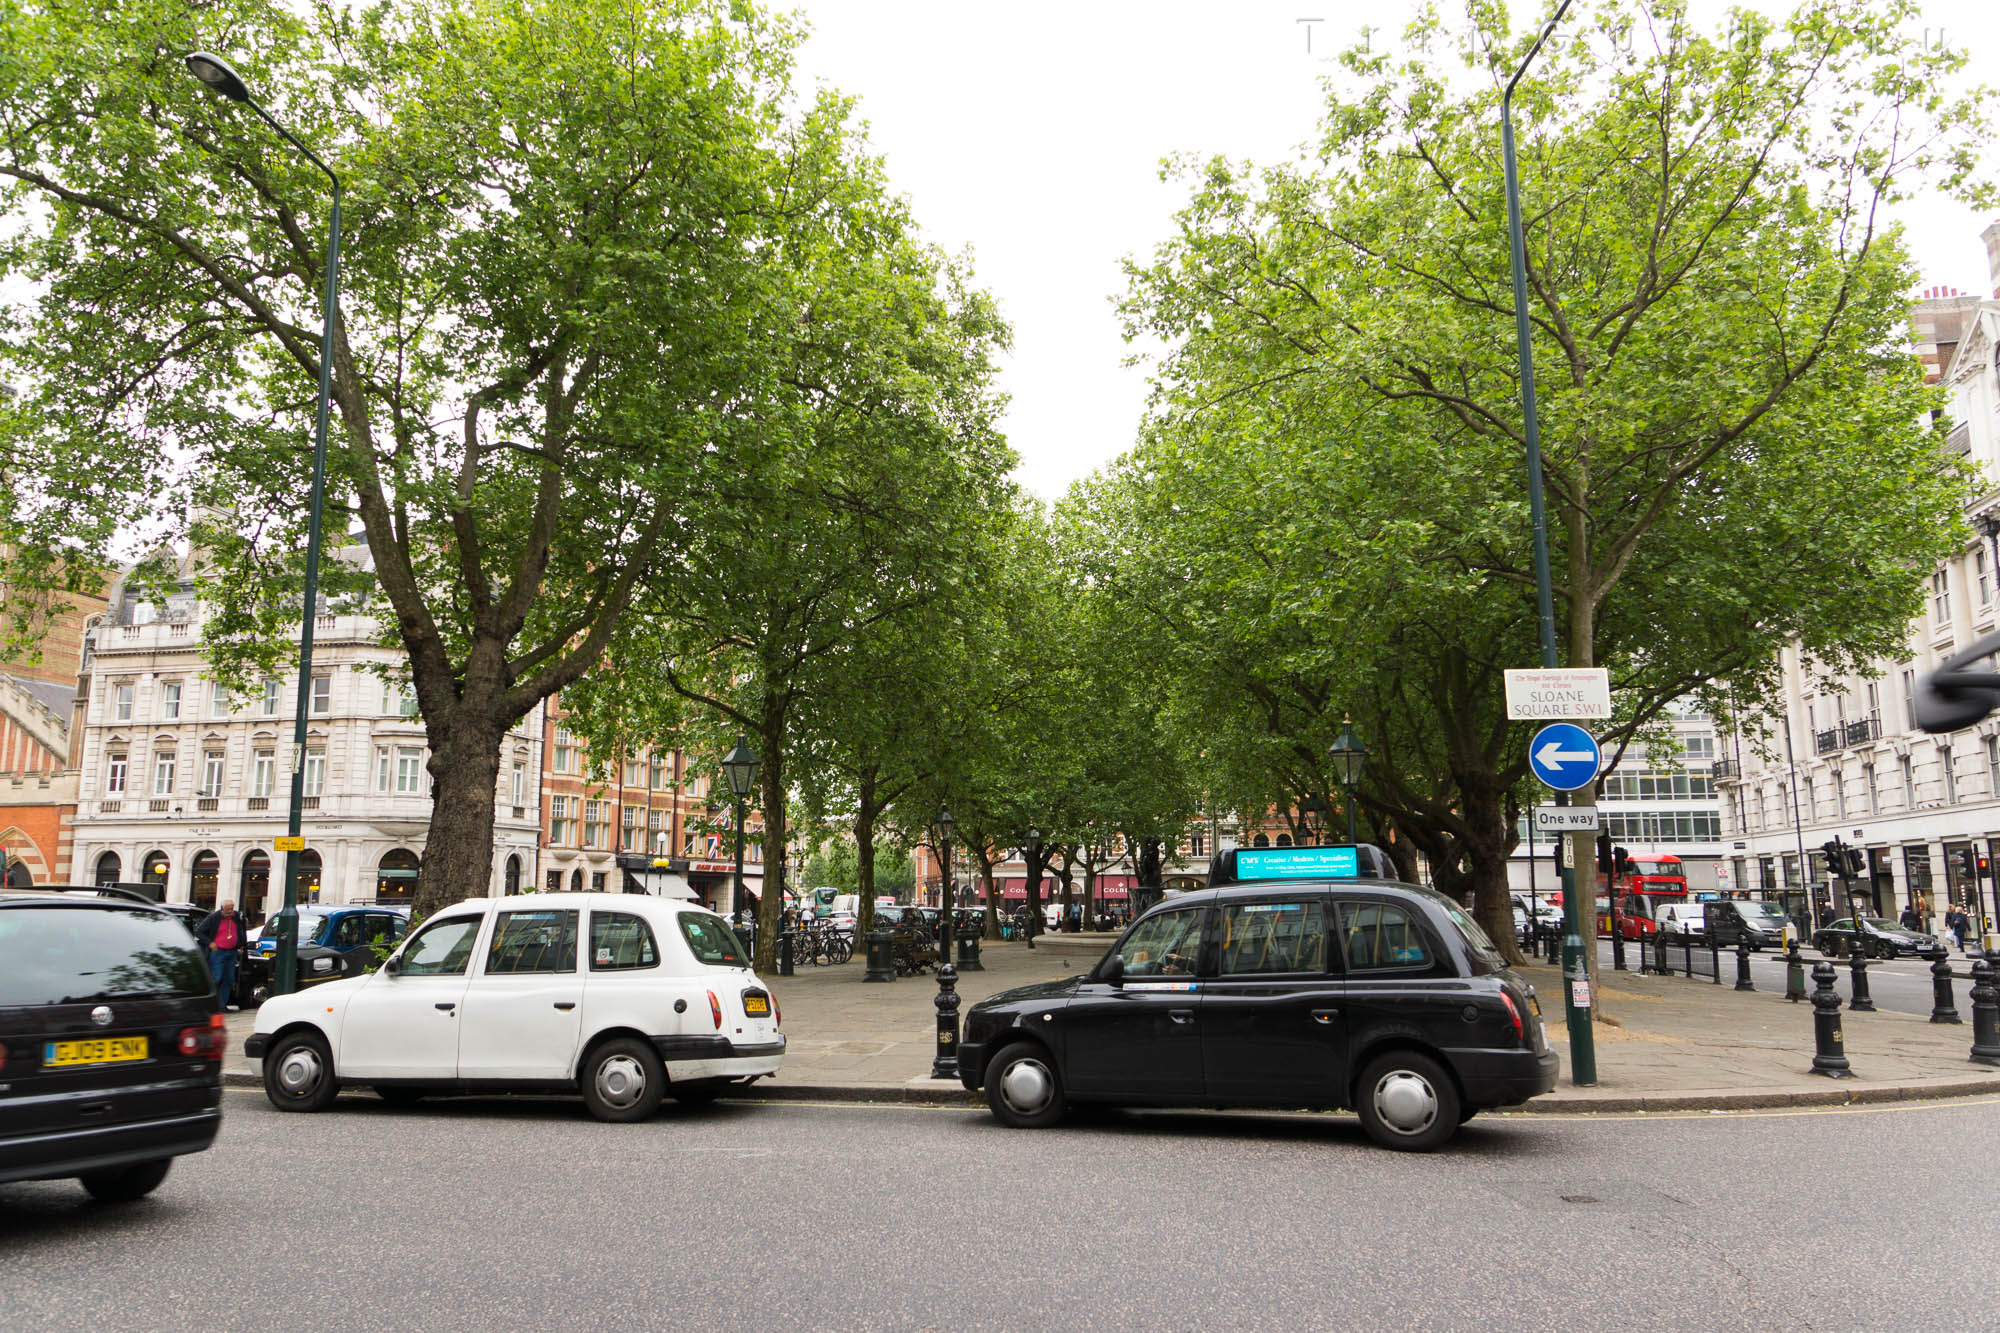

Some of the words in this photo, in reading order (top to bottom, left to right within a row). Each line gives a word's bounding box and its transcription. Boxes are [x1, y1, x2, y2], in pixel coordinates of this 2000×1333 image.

[1530, 691, 1585, 703] SLOANE
[1539, 813, 1565, 824] One
[1568, 814, 1594, 826] way
